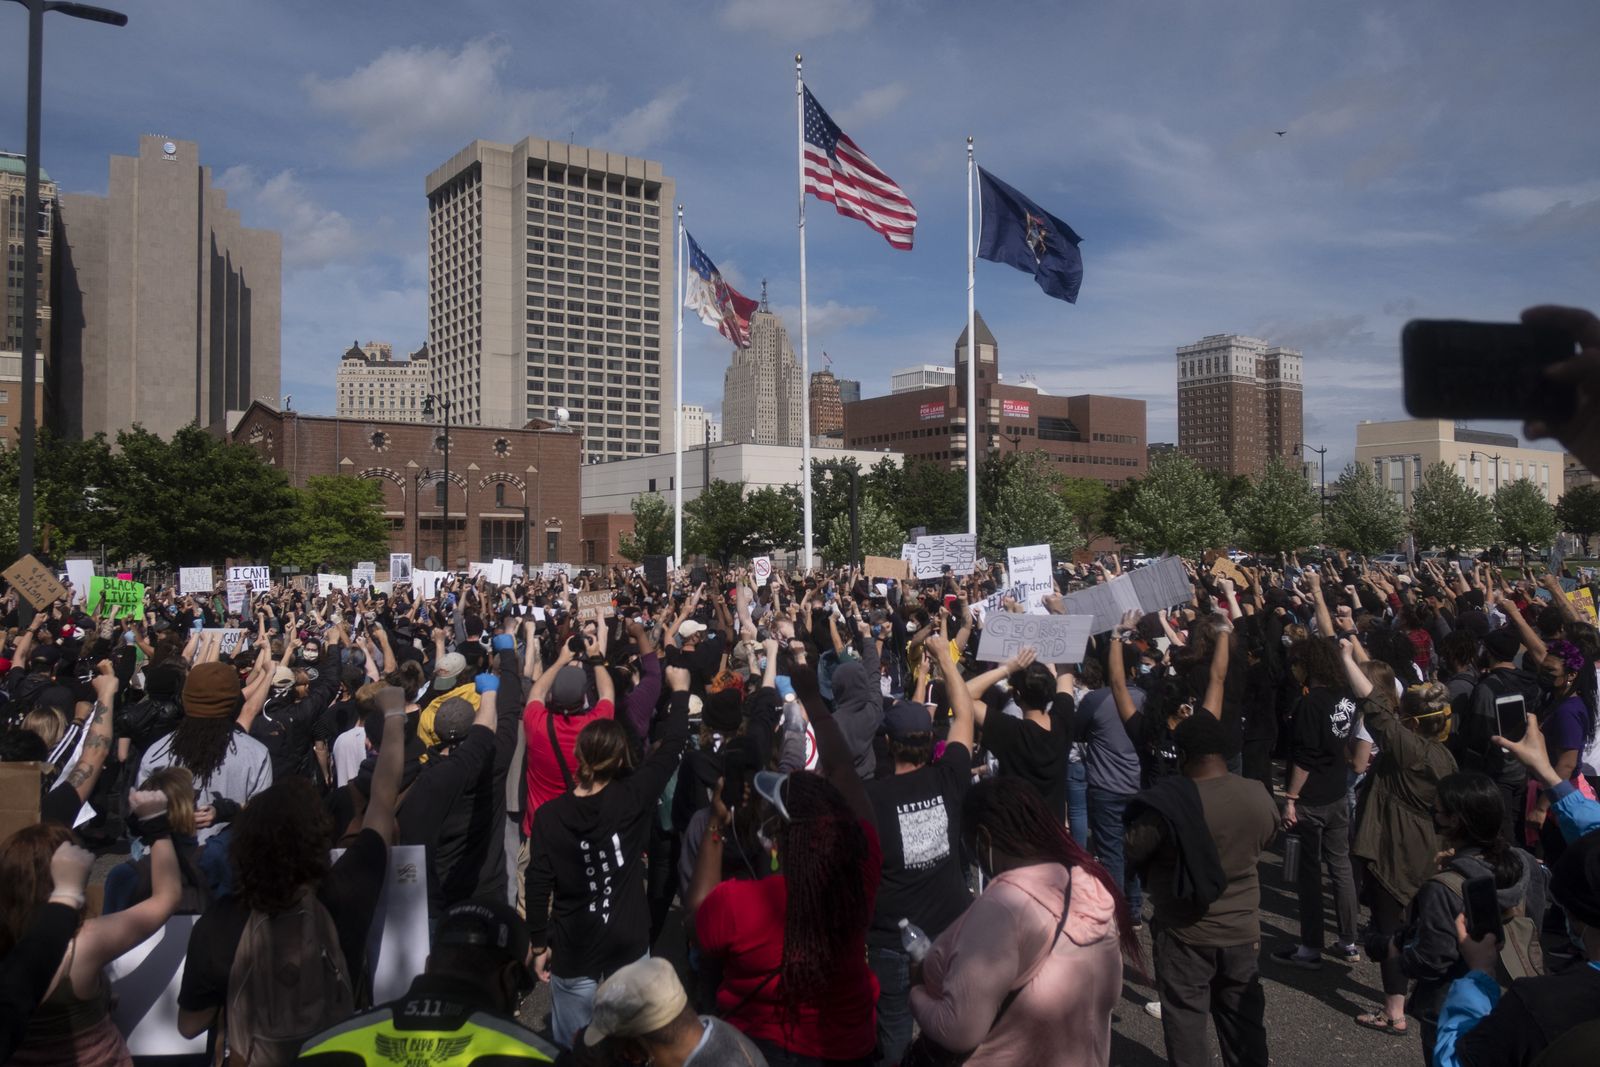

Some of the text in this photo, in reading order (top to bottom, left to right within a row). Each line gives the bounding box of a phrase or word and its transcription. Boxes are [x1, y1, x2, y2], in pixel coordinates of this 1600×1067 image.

[917, 543, 932, 574] STOP
[931, 536, 945, 574] KILLING
[945, 539, 961, 568] LACK
[957, 537, 976, 570] PEOPLE
[184, 575, 209, 583] POLICE
[233, 568, 241, 580] I
[103, 578, 137, 591] BLACK
[578, 593, 611, 606] ABOLISH
[103, 604, 137, 615] MTER
[986, 614, 1071, 640] GEORGE
[896, 794, 944, 814] LETTUCE
[476, 905, 496, 919] CITY
[403, 998, 442, 1017] 5.11
